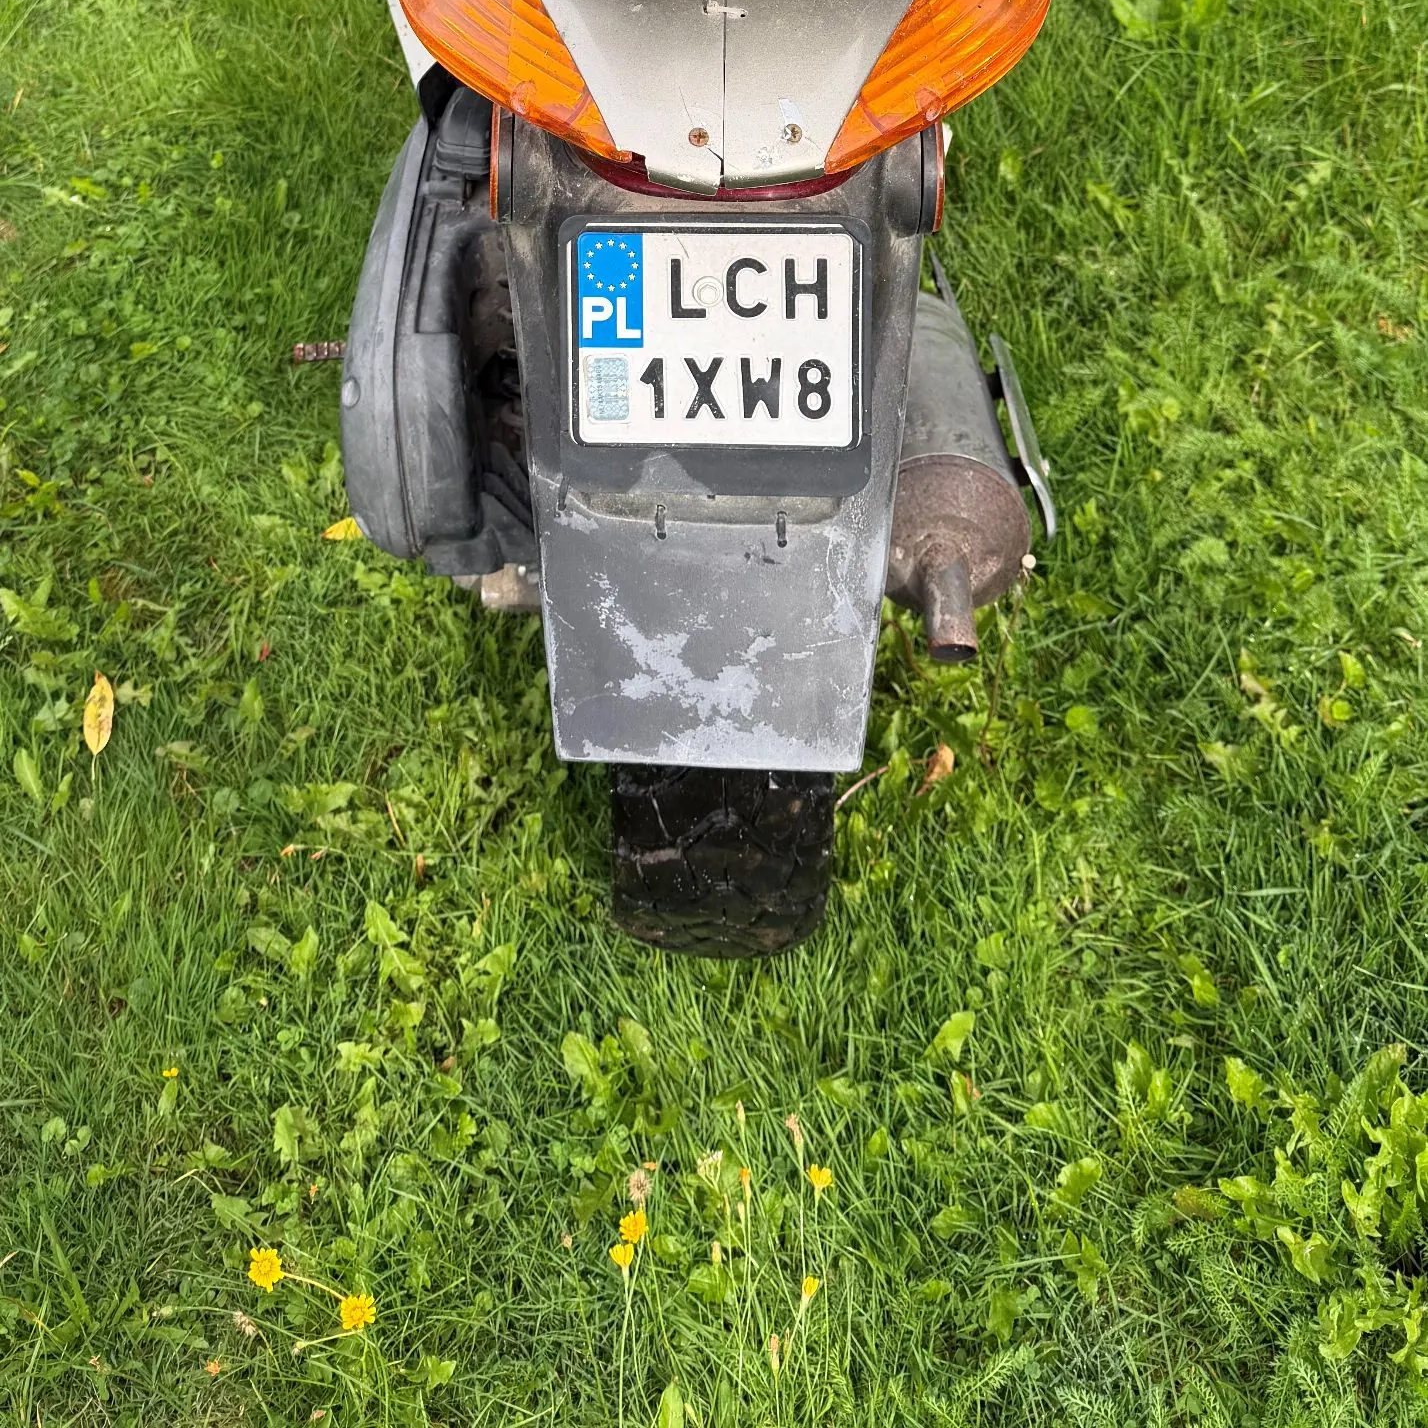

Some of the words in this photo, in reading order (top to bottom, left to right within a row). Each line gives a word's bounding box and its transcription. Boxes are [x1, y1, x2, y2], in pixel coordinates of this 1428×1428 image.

[582, 296, 641, 339] PL
[670, 257, 828, 320] LCH
[640, 357, 832, 420] 1XW8
